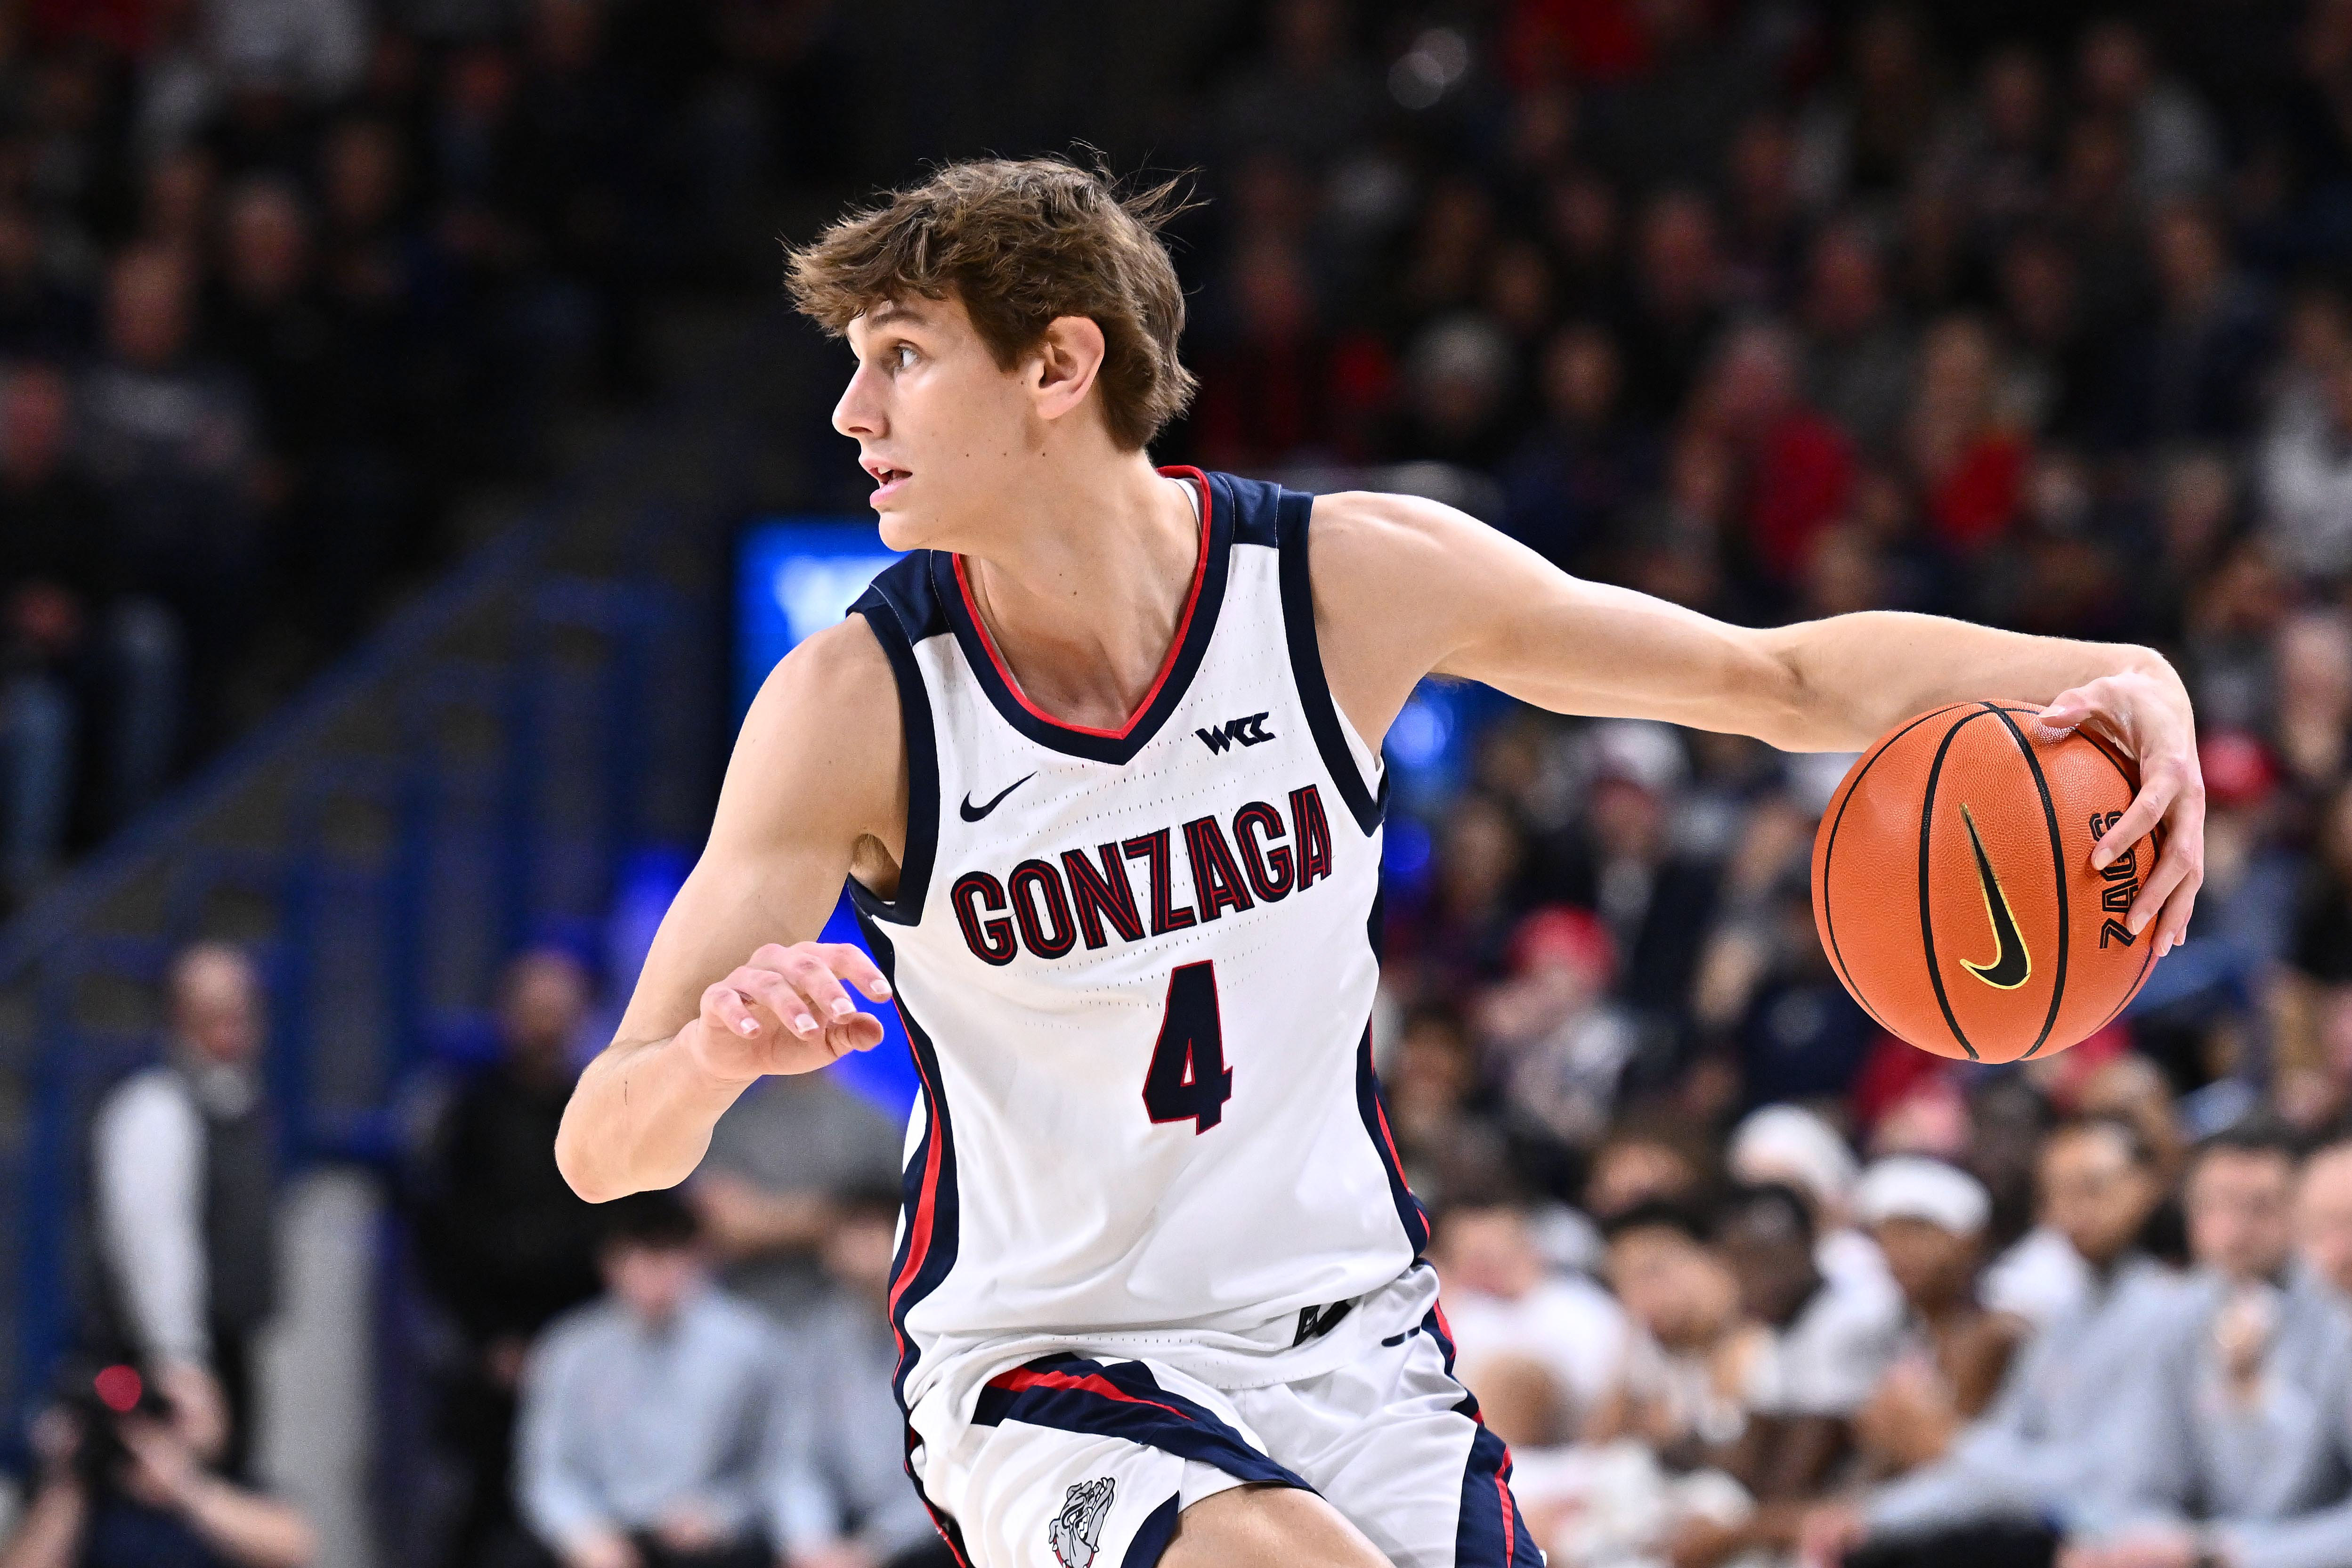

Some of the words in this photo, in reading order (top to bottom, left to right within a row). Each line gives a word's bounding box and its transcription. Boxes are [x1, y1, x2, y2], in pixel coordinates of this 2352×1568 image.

[1195, 711, 1276, 756] WCC
[950, 784, 1332, 966] GONZAGA
[1142, 959, 1232, 1135] 4
